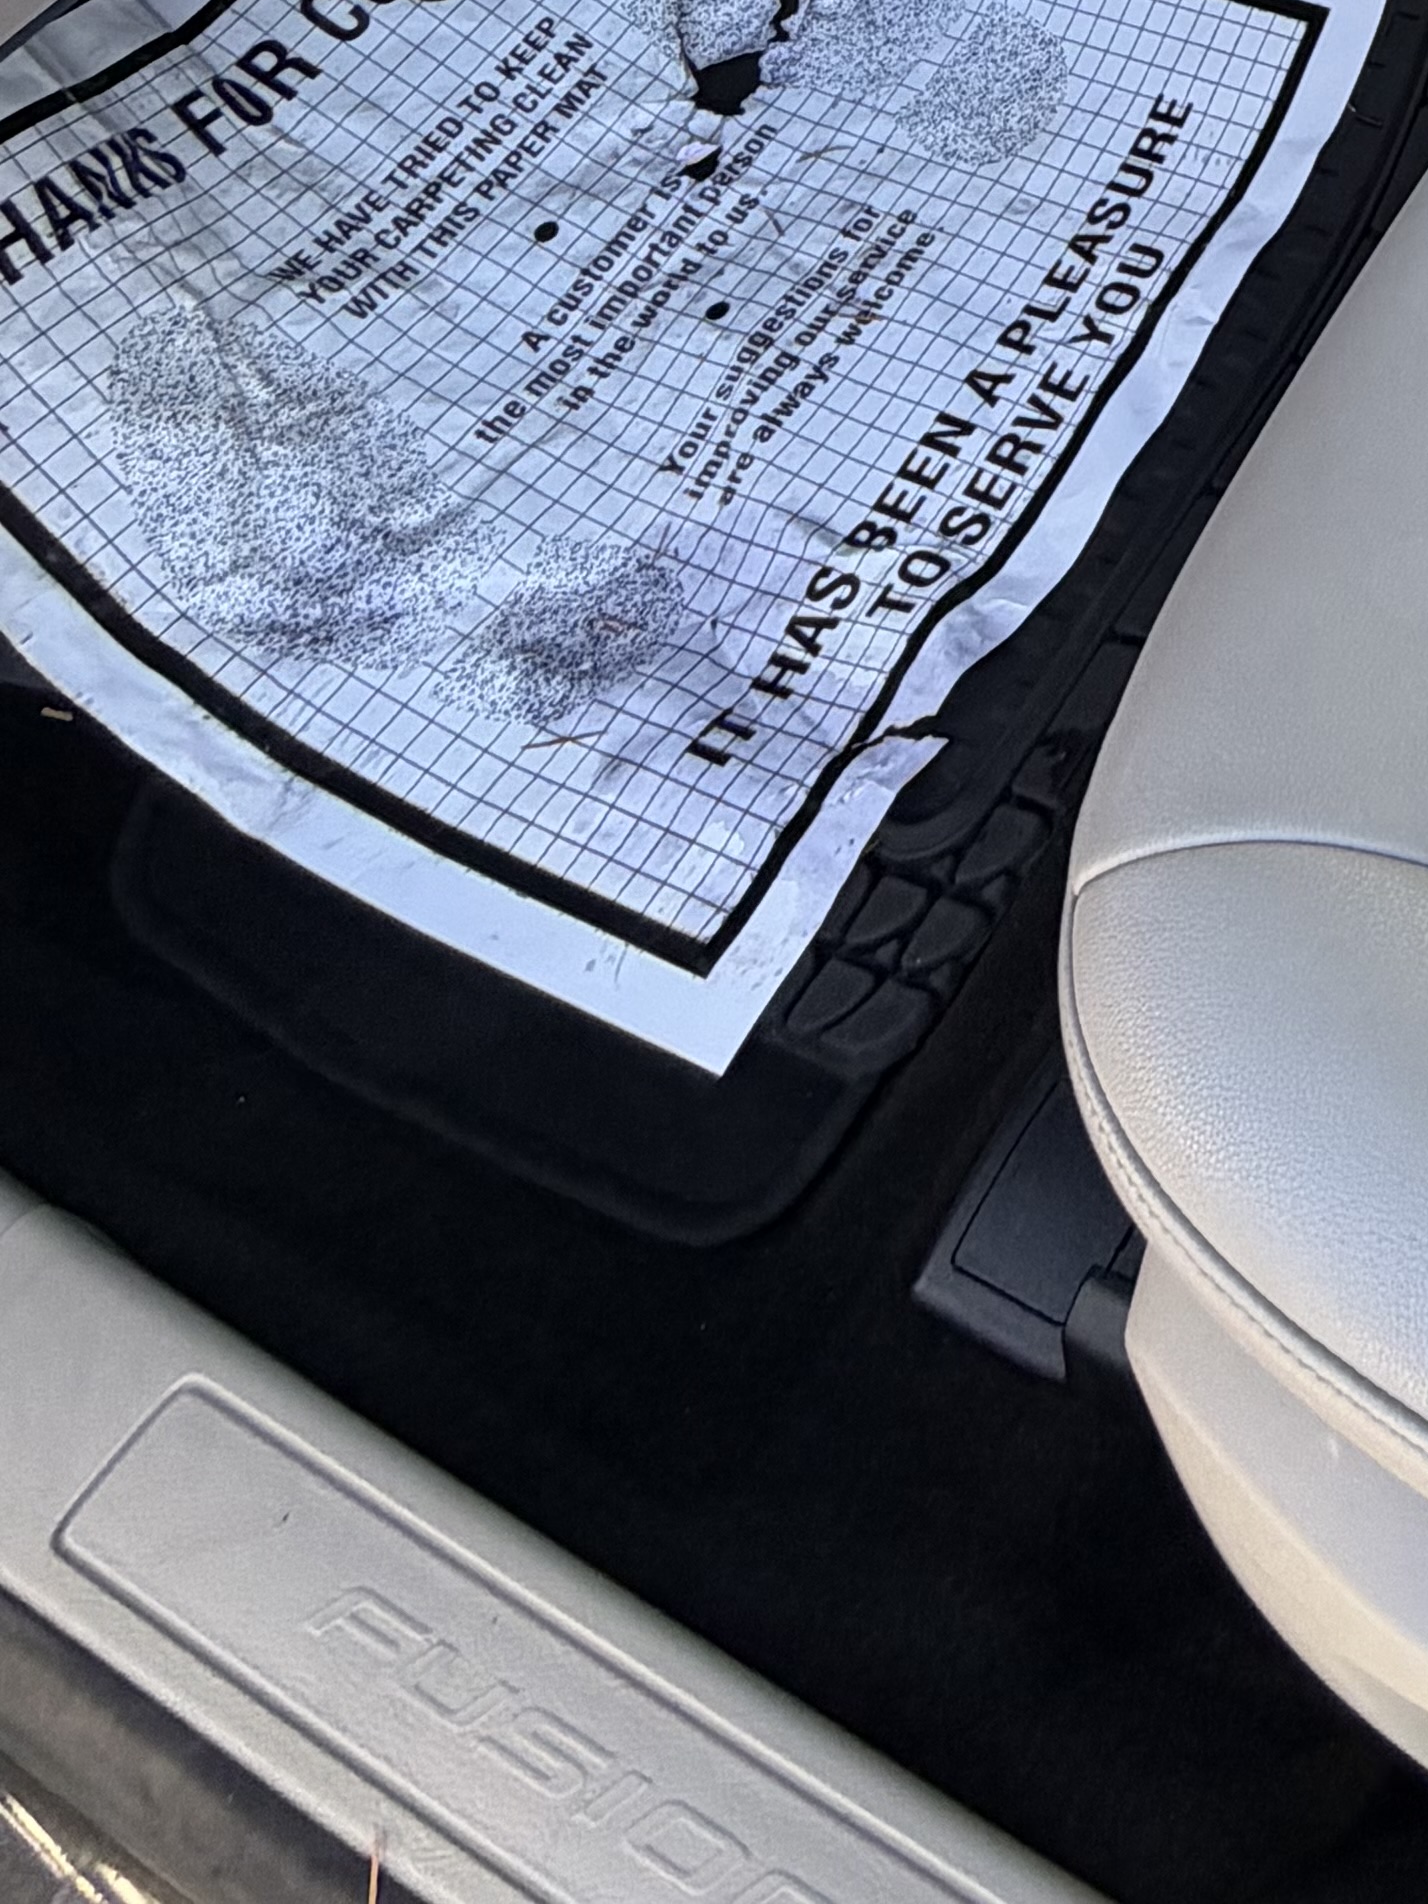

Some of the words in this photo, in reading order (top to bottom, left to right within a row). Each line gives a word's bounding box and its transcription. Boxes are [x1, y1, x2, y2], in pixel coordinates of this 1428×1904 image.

[172, 39, 323, 158] FOR
[270, 248, 322, 283] WE
[312, 190, 392, 254] HAVE
[381, 116, 464, 190] TRIED
[457, 80, 500, 115] TO
[495, 16, 558, 81] KEEP
[299, 247, 380, 306] YOUR
[374, 113, 518, 251] CARPETING
[512, 32, 595, 113] CLEAN
[343, 261, 421, 321] WITH
[411, 201, 481, 260] THIS
[474, 119, 559, 201] PAPER
[552, 62, 608, 119] MAT
[474, 400, 527, 444] the
[524, 333, 594, 396] most
[586, 203, 698, 331] important
[698, 122, 778, 206] person
[521, 330, 551, 353] A
[547, 203, 657, 327] customer
[651, 170, 684, 201] is
[556, 384, 595, 411] in
[587, 336, 636, 380] the
[632, 258, 703, 329] world
[697, 229, 729, 256] to
[659, 408, 718, 475] Your
[715, 247, 850, 401] suggestions
[841, 205, 882, 242] for
[684, 351, 801, 500] improving
[794, 303, 841, 350] our
[836, 208, 918, 302] service
[687, 707, 758, 768] IT
[750, 565, 863, 701] HAS
[843, 411, 977, 552] BEEN
[962, 367, 1015, 409] A
[997, 93, 1196, 357] PLEASURE
[718, 452, 755, 507] are
[753, 352, 841, 444] always
[865, 548, 952, 619] TO
[938, 360, 1091, 547] SERVE
[1072, 242, 1167, 350] YOU
